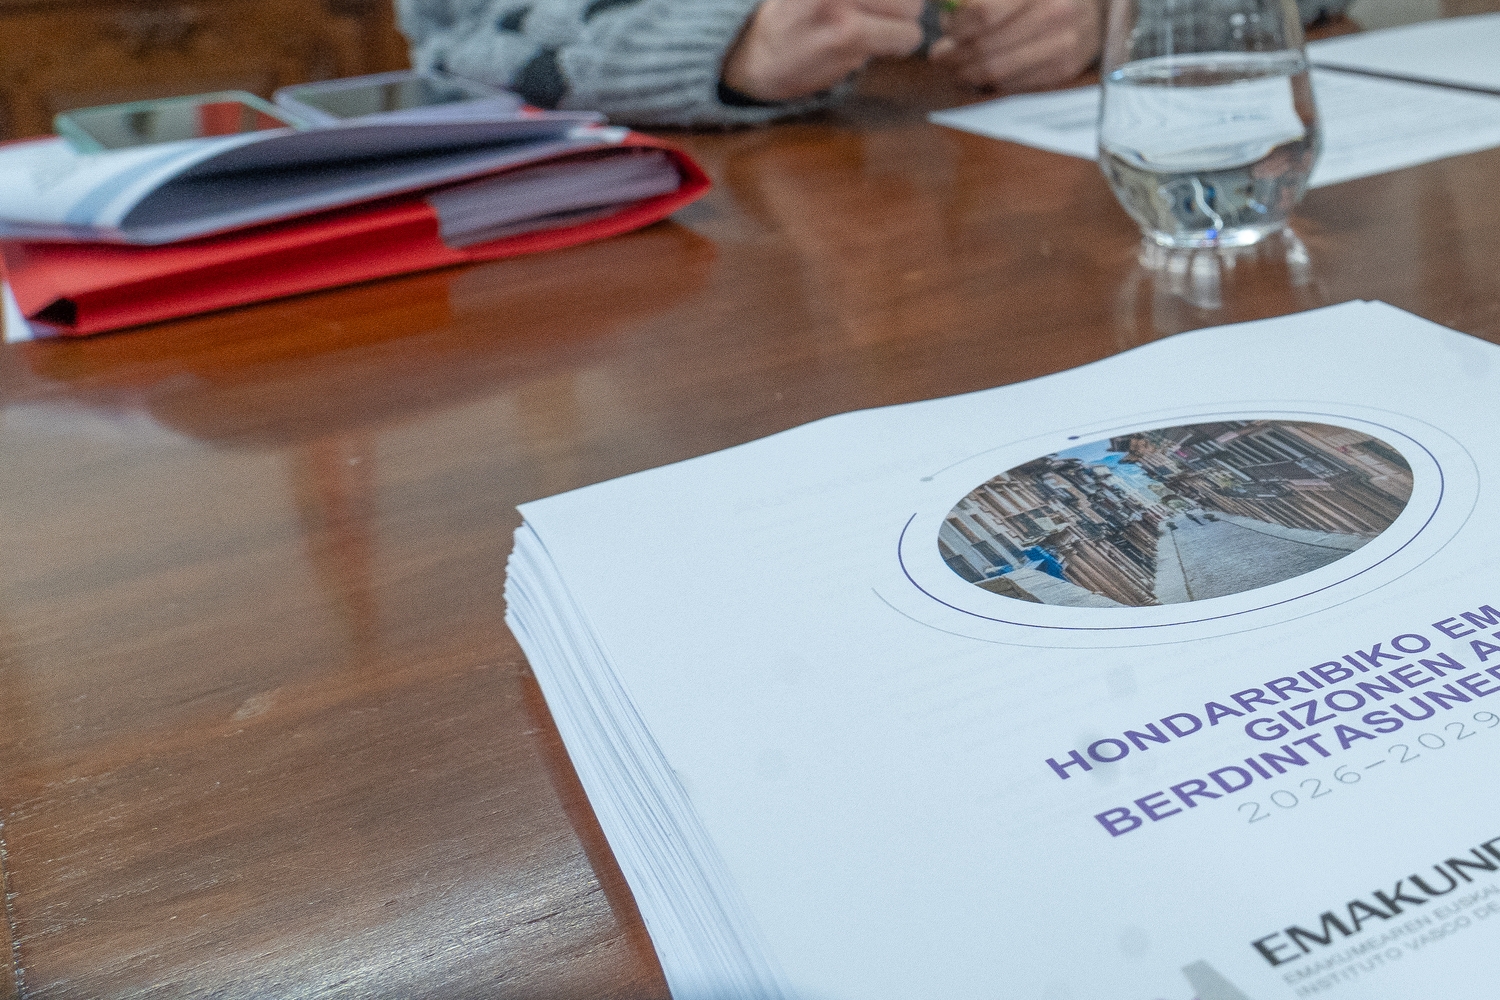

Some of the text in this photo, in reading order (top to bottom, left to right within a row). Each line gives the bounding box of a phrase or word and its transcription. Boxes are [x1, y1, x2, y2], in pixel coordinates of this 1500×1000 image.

[1045, 633, 1431, 780] HONDARRIBIKO
[1244, 652, 1466, 741] GIZONEN
[1281, 914, 1432, 985] EMAKUMEAREN
[1295, 946, 1403, 998] INSTITUTO
[1403, 914, 1472, 951] VASCO
